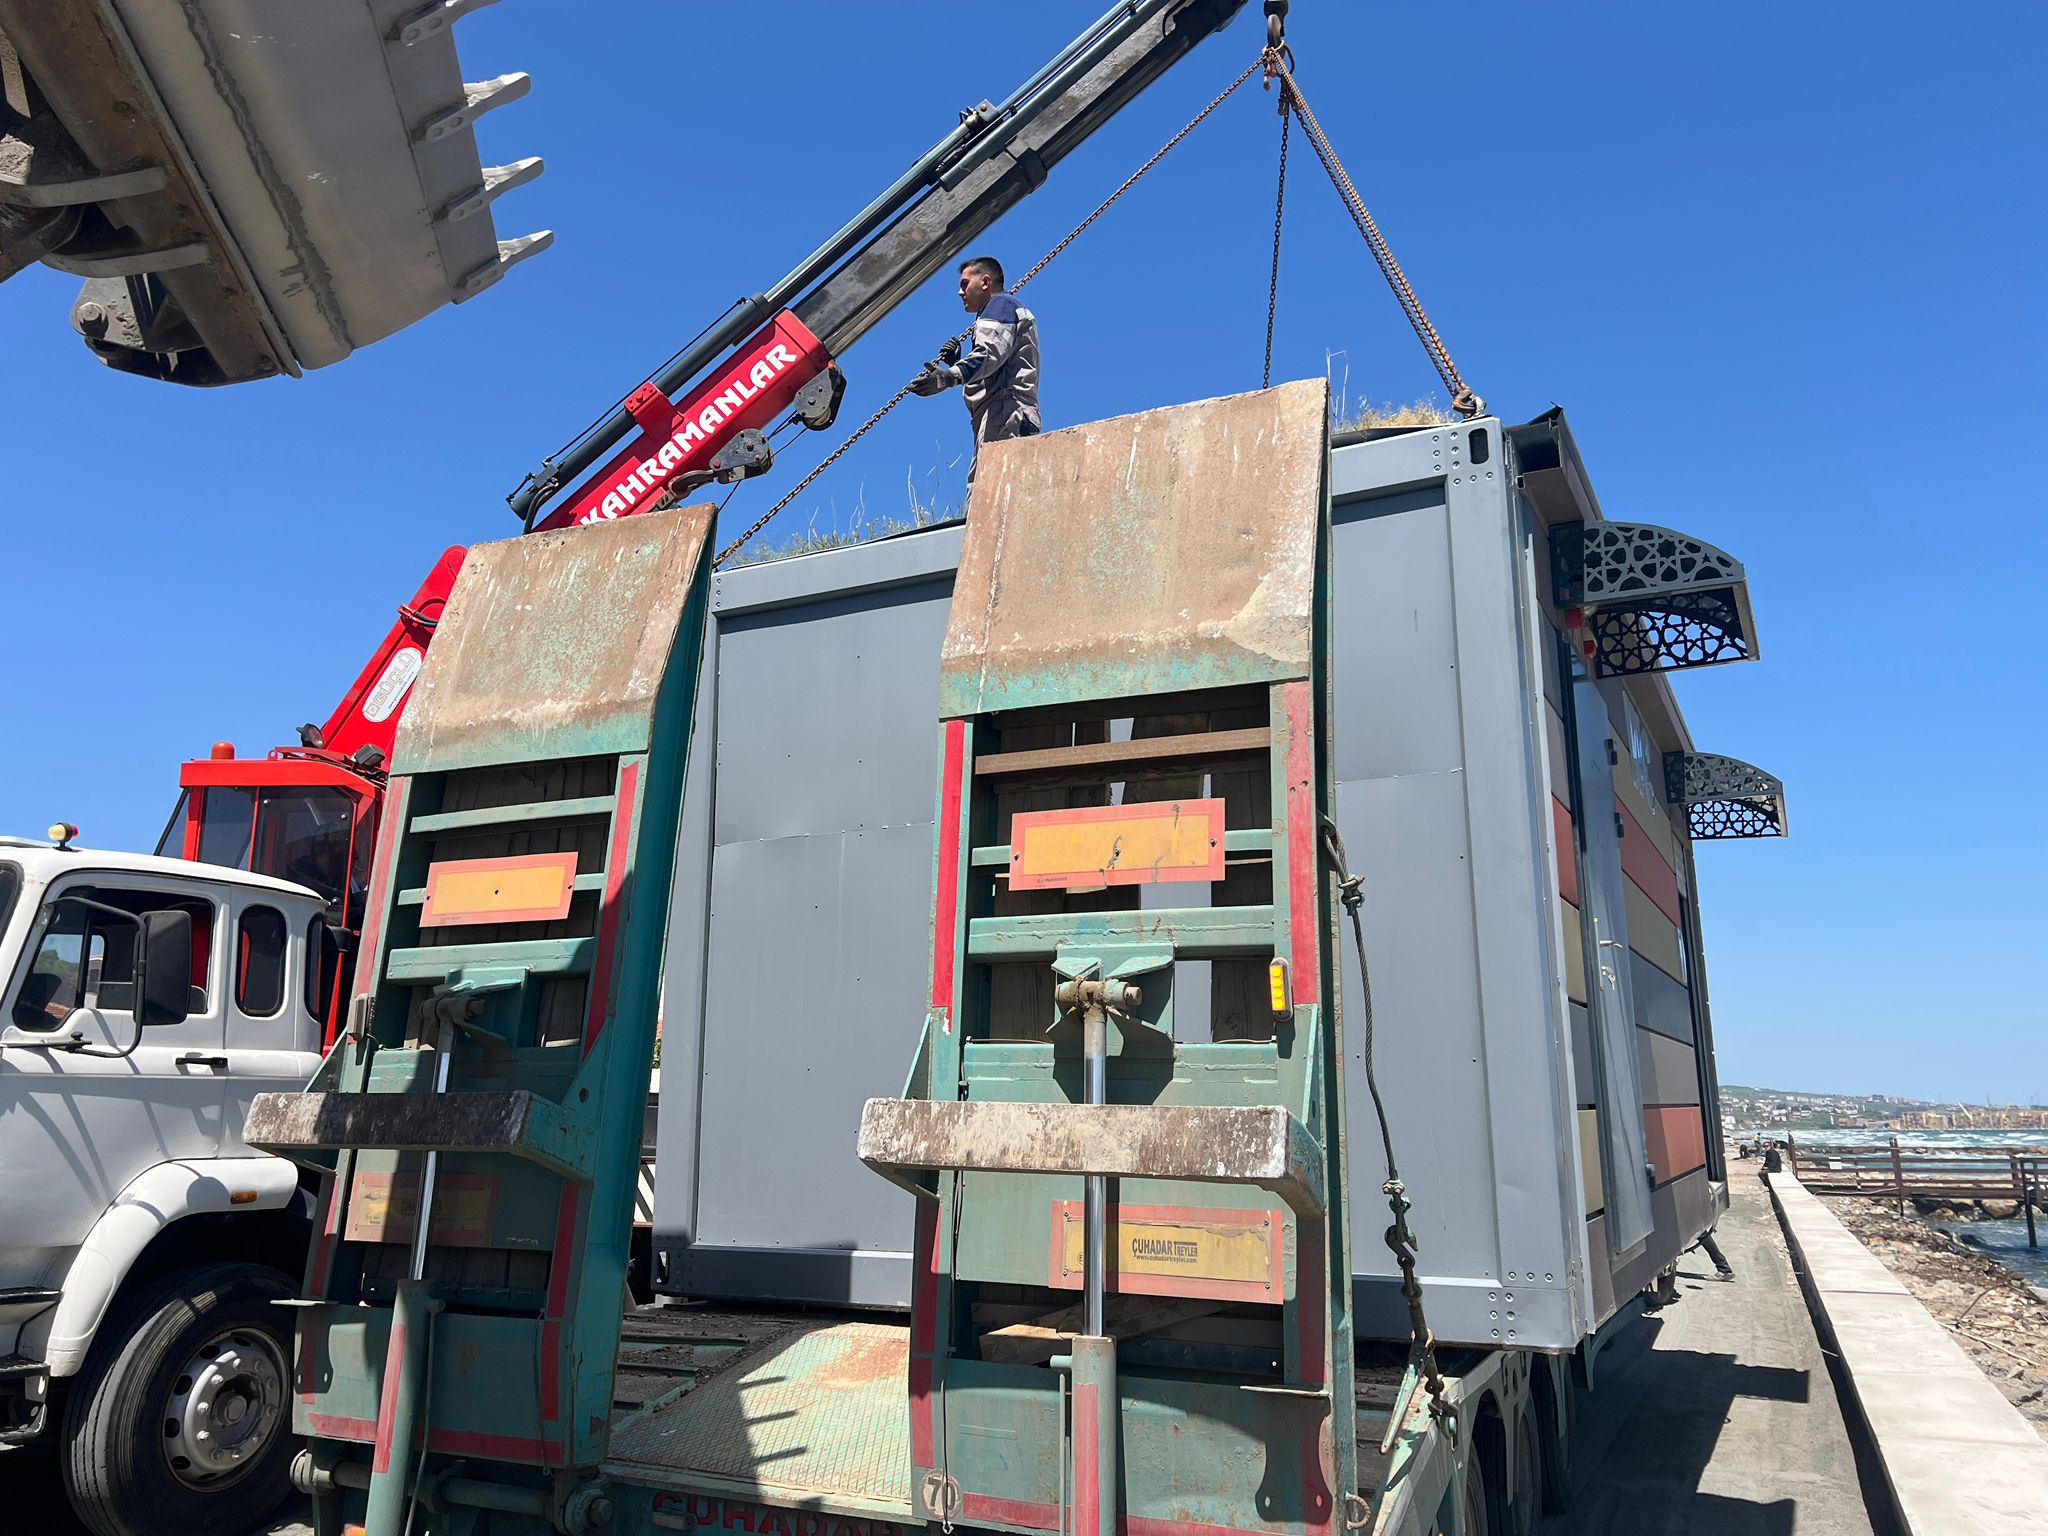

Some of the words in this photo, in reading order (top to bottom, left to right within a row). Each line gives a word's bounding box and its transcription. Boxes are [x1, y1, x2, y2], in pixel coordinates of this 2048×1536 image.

[580, 344, 797, 526] KAHRAMANLAR
[1132, 1238, 1173, 1257] ÇUHADAR
[1173, 1241, 1198, 1257] TREYLER
[927, 1476, 956, 1511] 70
